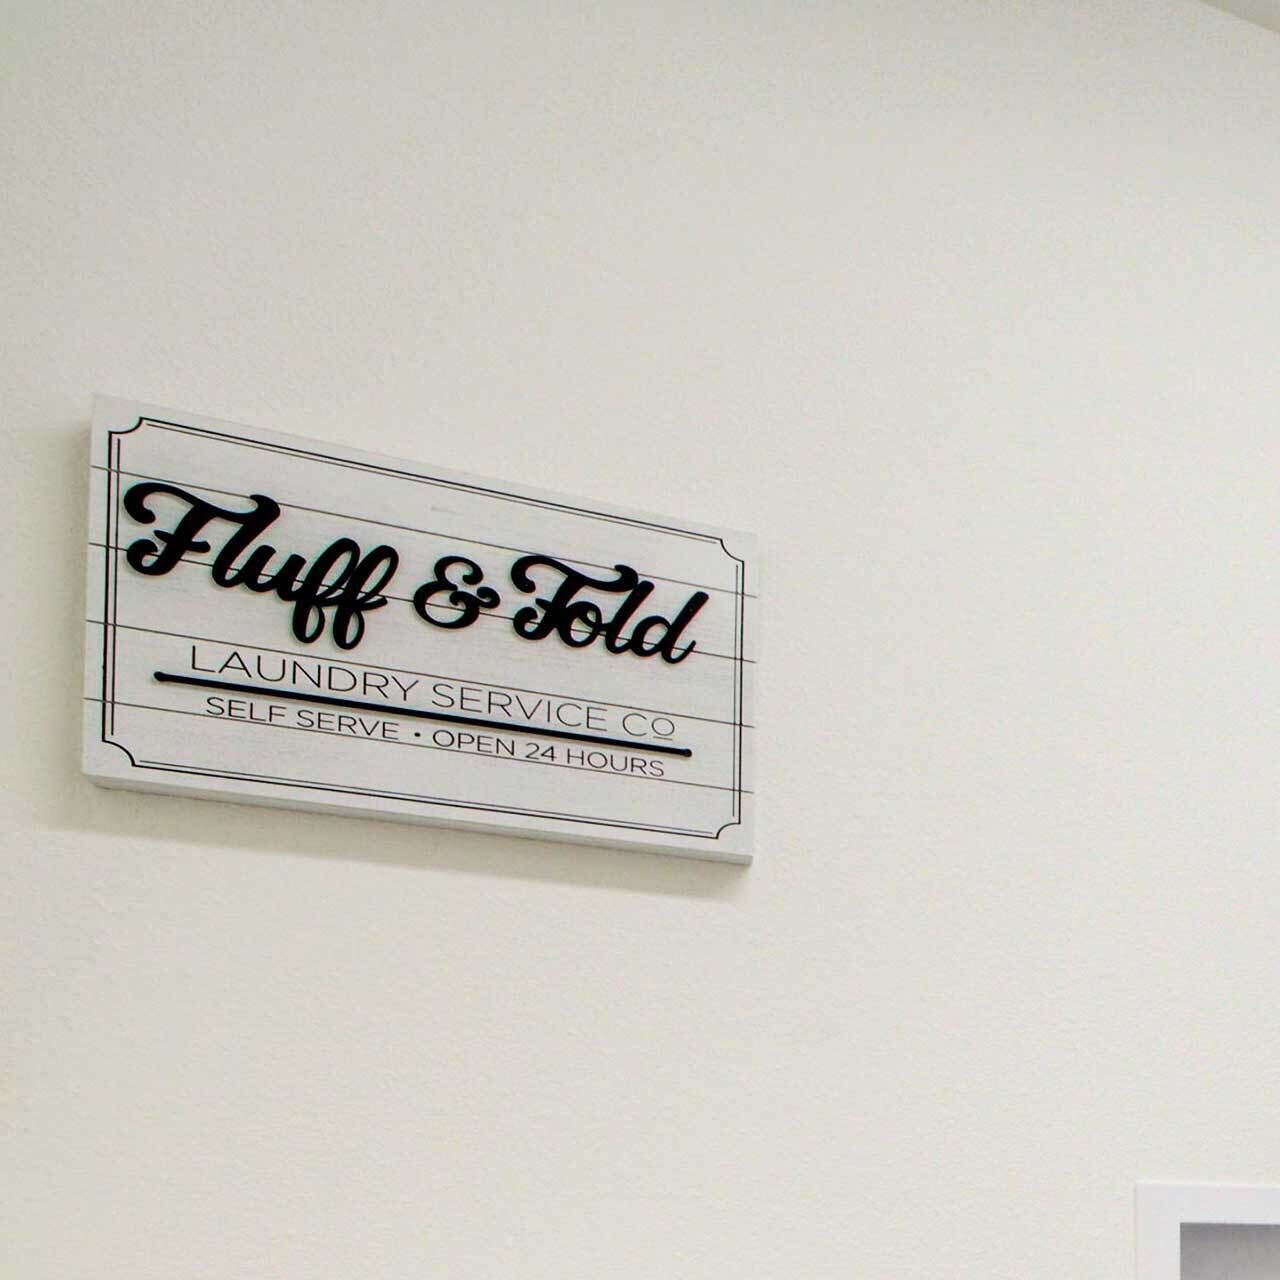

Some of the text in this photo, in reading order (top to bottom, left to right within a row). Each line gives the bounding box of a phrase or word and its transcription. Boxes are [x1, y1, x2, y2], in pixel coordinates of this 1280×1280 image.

[122, 482, 710, 664] Fluff & Fold
[191, 645, 419, 701] LAUNDRY
[431, 683, 608, 732] SERVICE
[206, 696, 665, 777] SELF SERVE OPEN 24 HOURS
